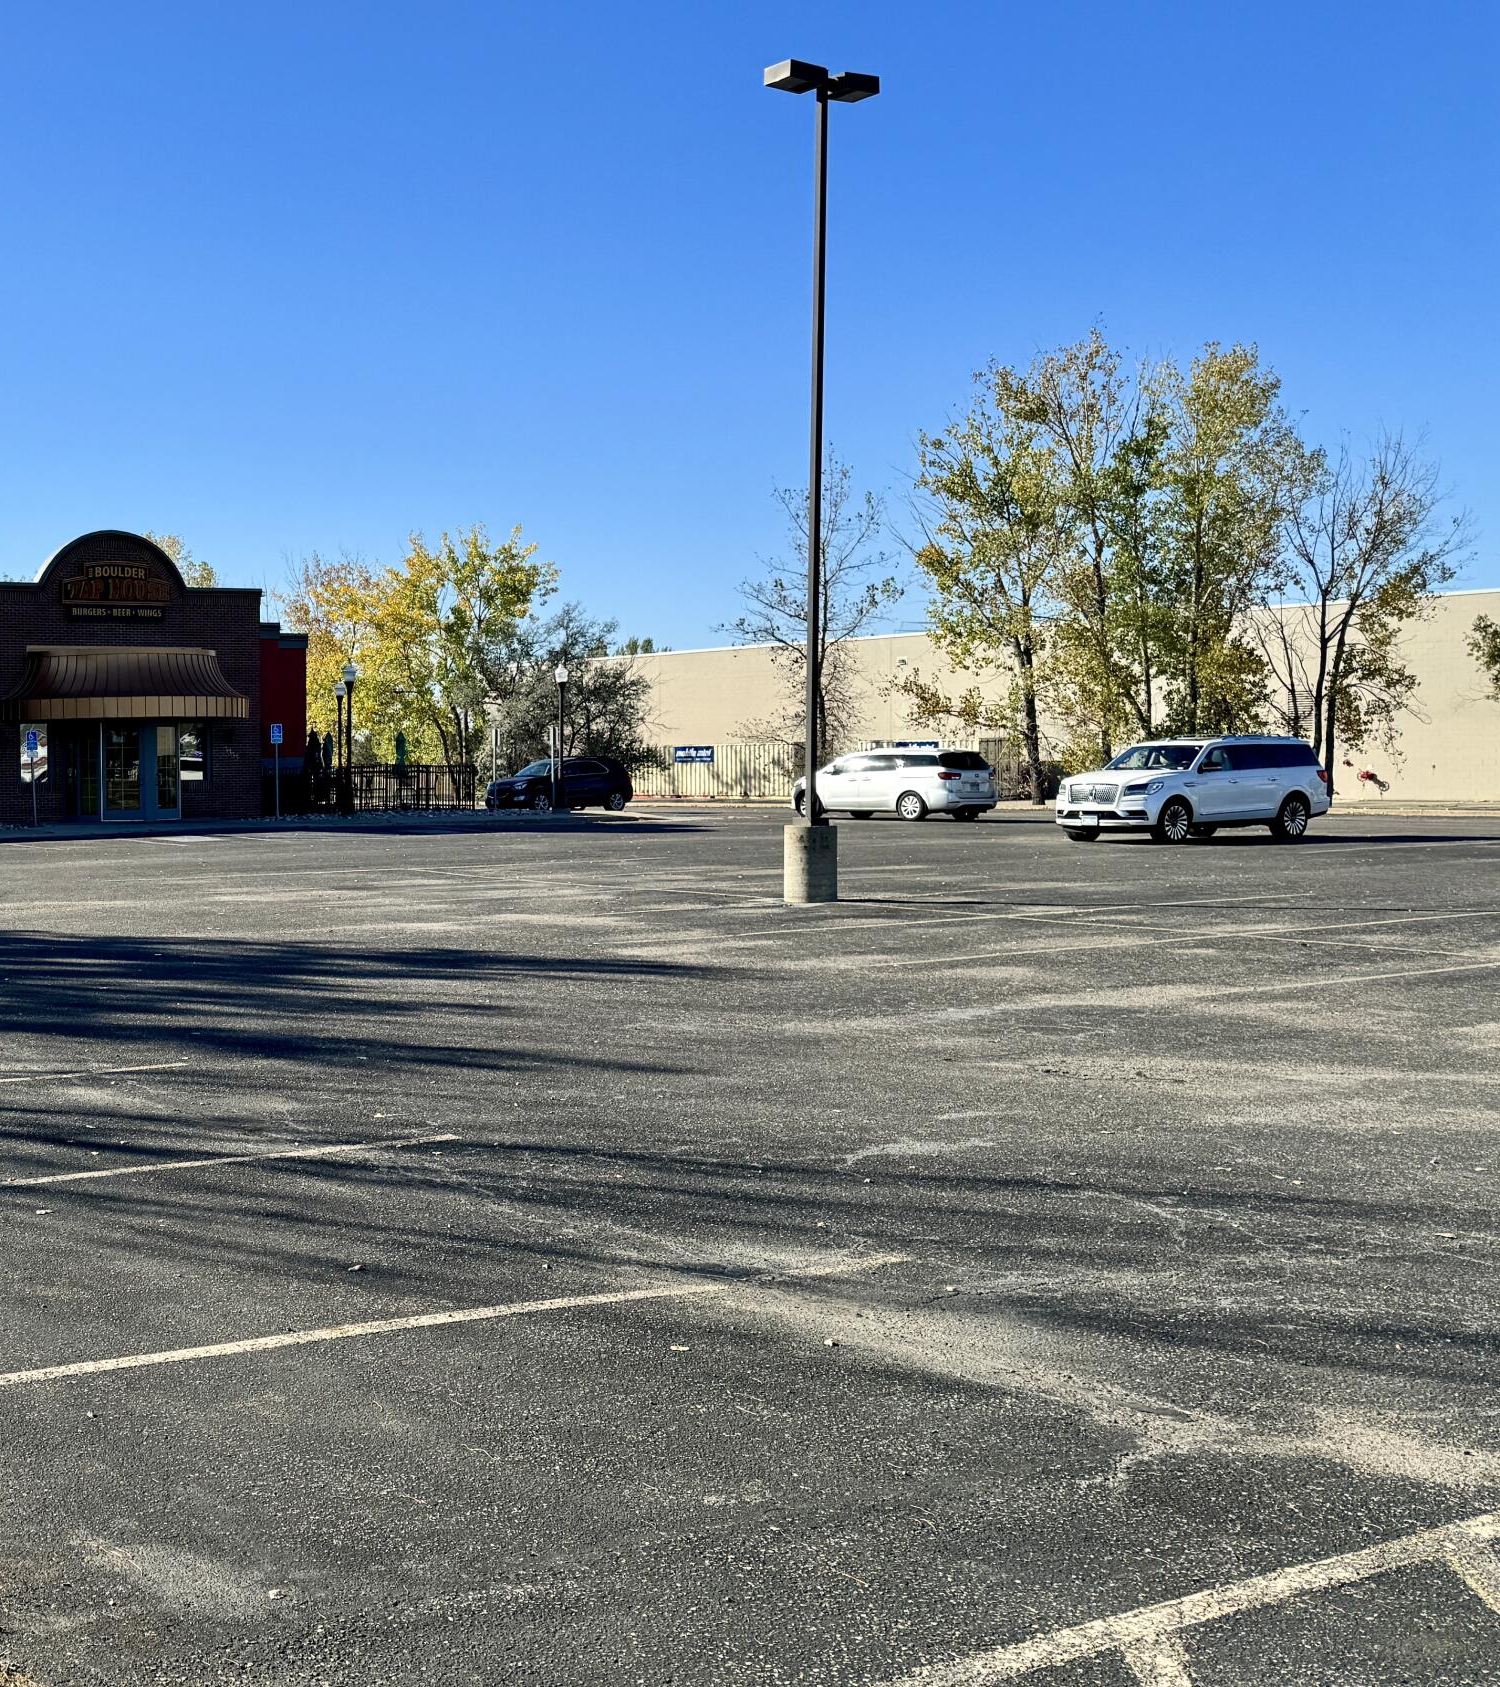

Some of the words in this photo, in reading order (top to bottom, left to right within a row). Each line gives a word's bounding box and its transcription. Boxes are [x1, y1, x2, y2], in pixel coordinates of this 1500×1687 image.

[95, 566, 145, 579] BOULDER
[68, 578, 104, 600] TAP
[109, 578, 169, 600] HOUSE
[72, 607, 106, 616] BURGERS
[113, 608, 131, 617] BEER
[137, 609, 163, 617] WINGS
